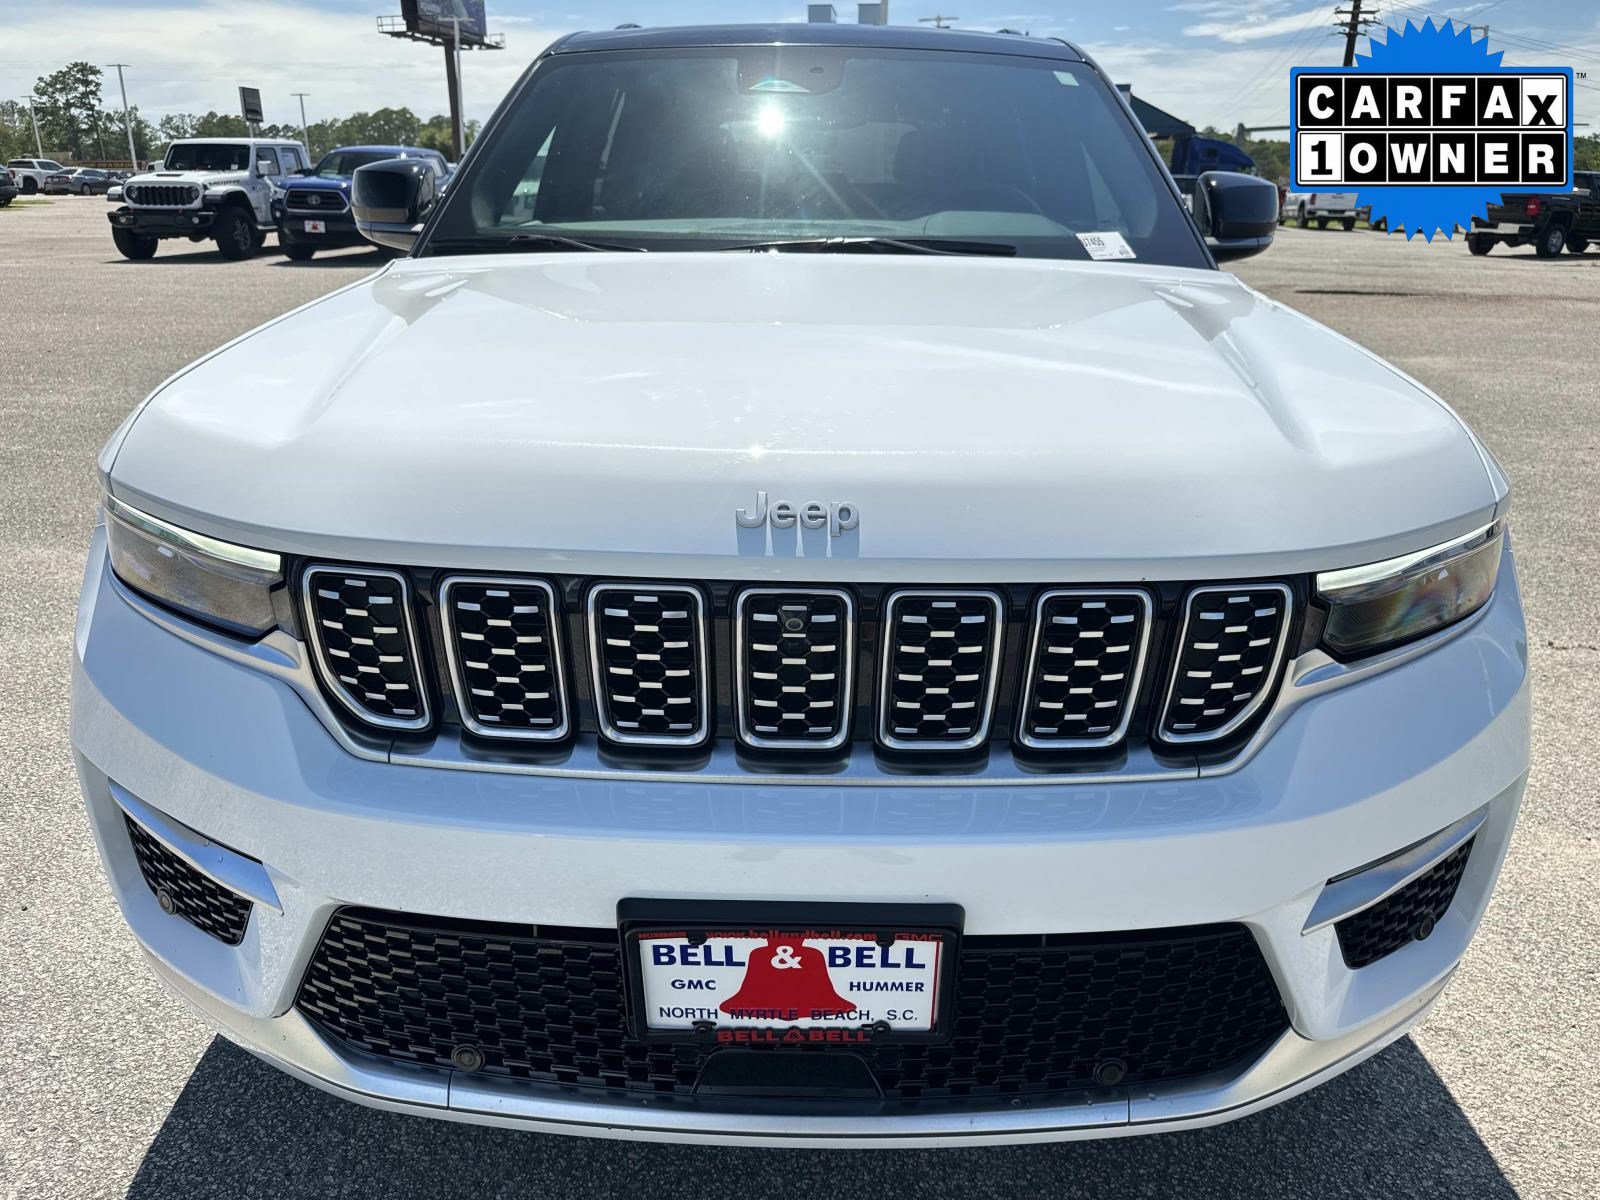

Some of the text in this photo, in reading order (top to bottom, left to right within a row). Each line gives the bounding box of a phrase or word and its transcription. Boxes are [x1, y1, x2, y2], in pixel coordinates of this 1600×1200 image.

[736, 491, 860, 537] Jeep
[705, 928, 878, 941] www.bellandbell.com
[895, 933, 943, 941] GMC
[652, 944, 926, 969] BELL & BELL
[671, 979, 717, 990] GMC
[849, 981, 925, 992] HUMMER
[659, 1007, 918, 1021] NORTH MYRTLE BEACH, S.C.
[716, 1030, 780, 1042] BELL
[808, 1030, 871, 1042] BELL
